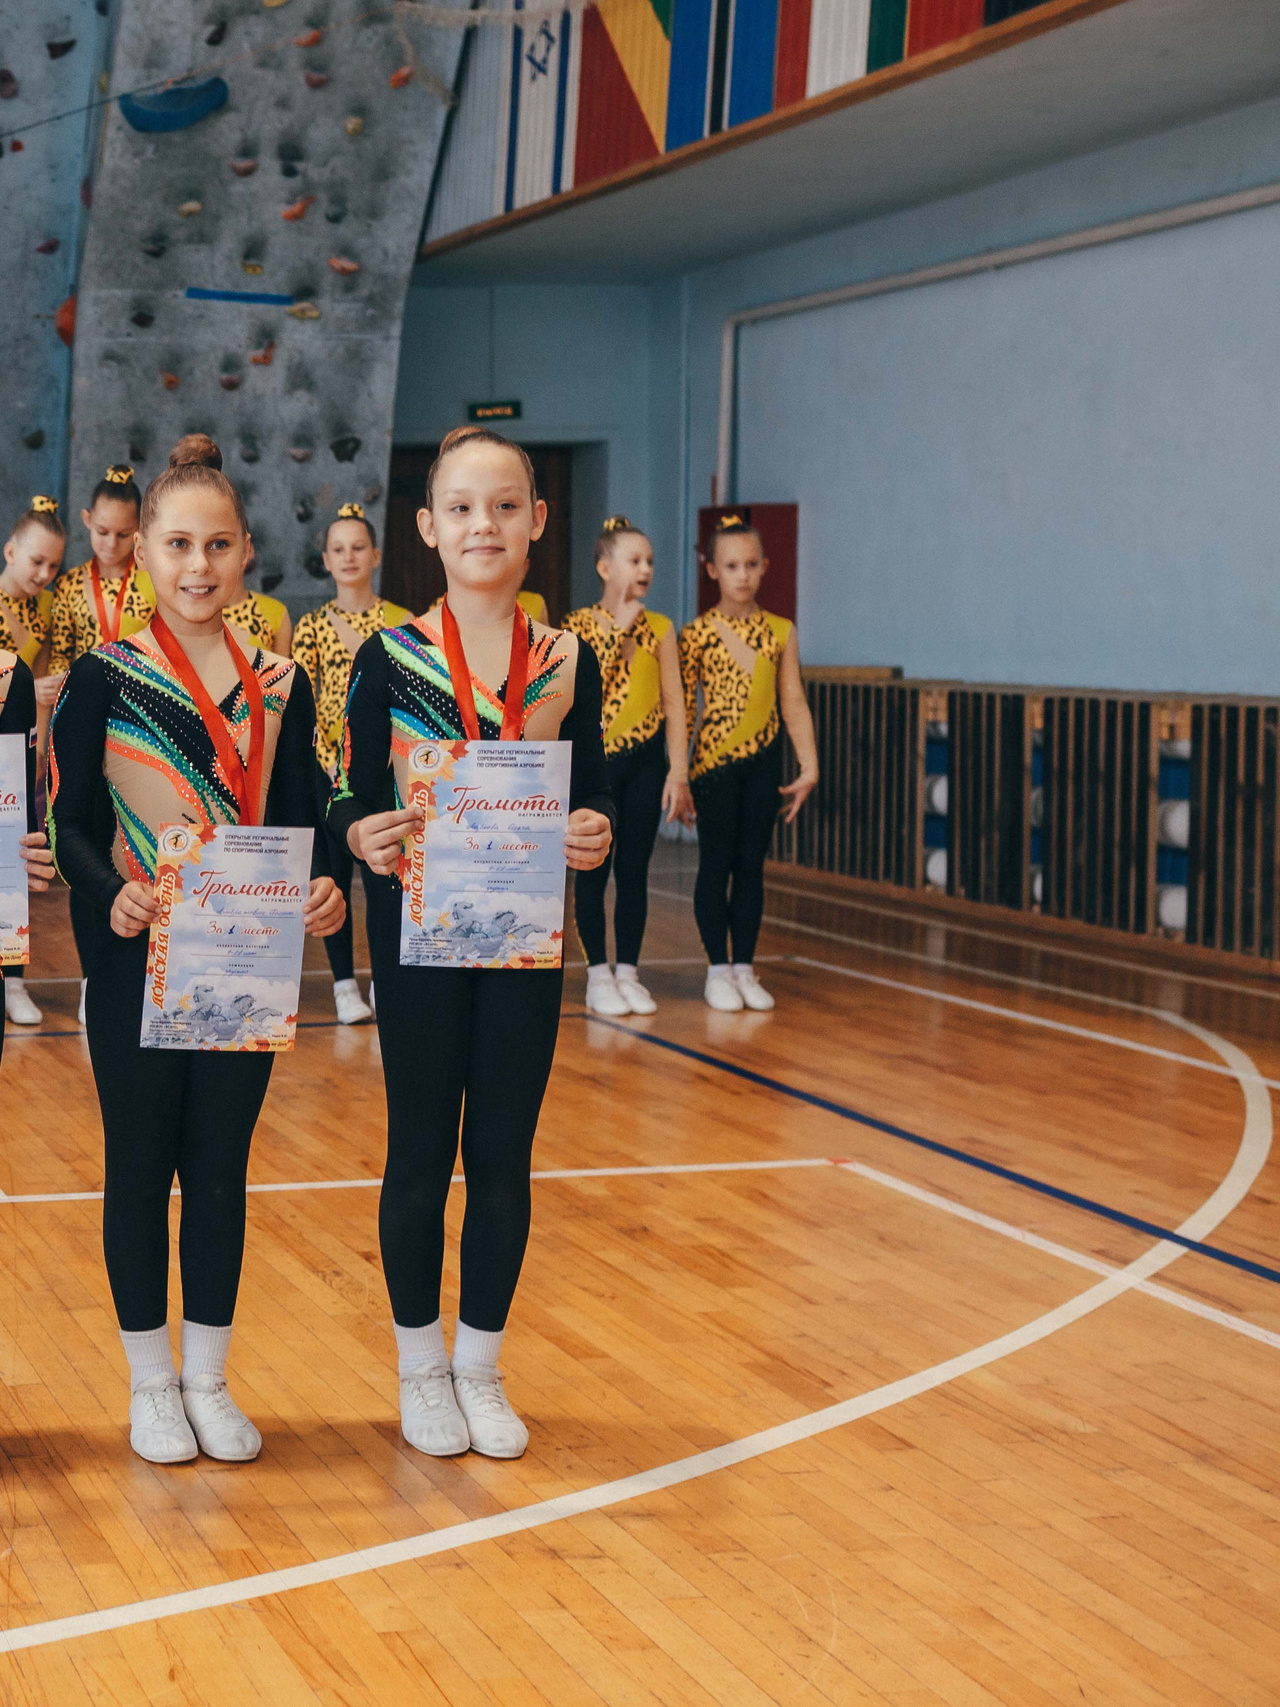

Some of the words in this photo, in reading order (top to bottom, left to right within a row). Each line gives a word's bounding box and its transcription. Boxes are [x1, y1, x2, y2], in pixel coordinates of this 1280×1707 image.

[447, 786, 561, 824] Грамота
[463, 837, 480, 850] За
[487, 841, 493, 850] 1
[499, 841, 539, 850] место
[192, 870, 301, 908] Грамота
[410, 850, 424, 926] ДОНСКАЯ
[207, 921, 223, 934] За
[228, 925, 235, 934] 1
[241, 926, 280, 935] место
[152, 932, 169, 1009] ДОНСКАЯ
